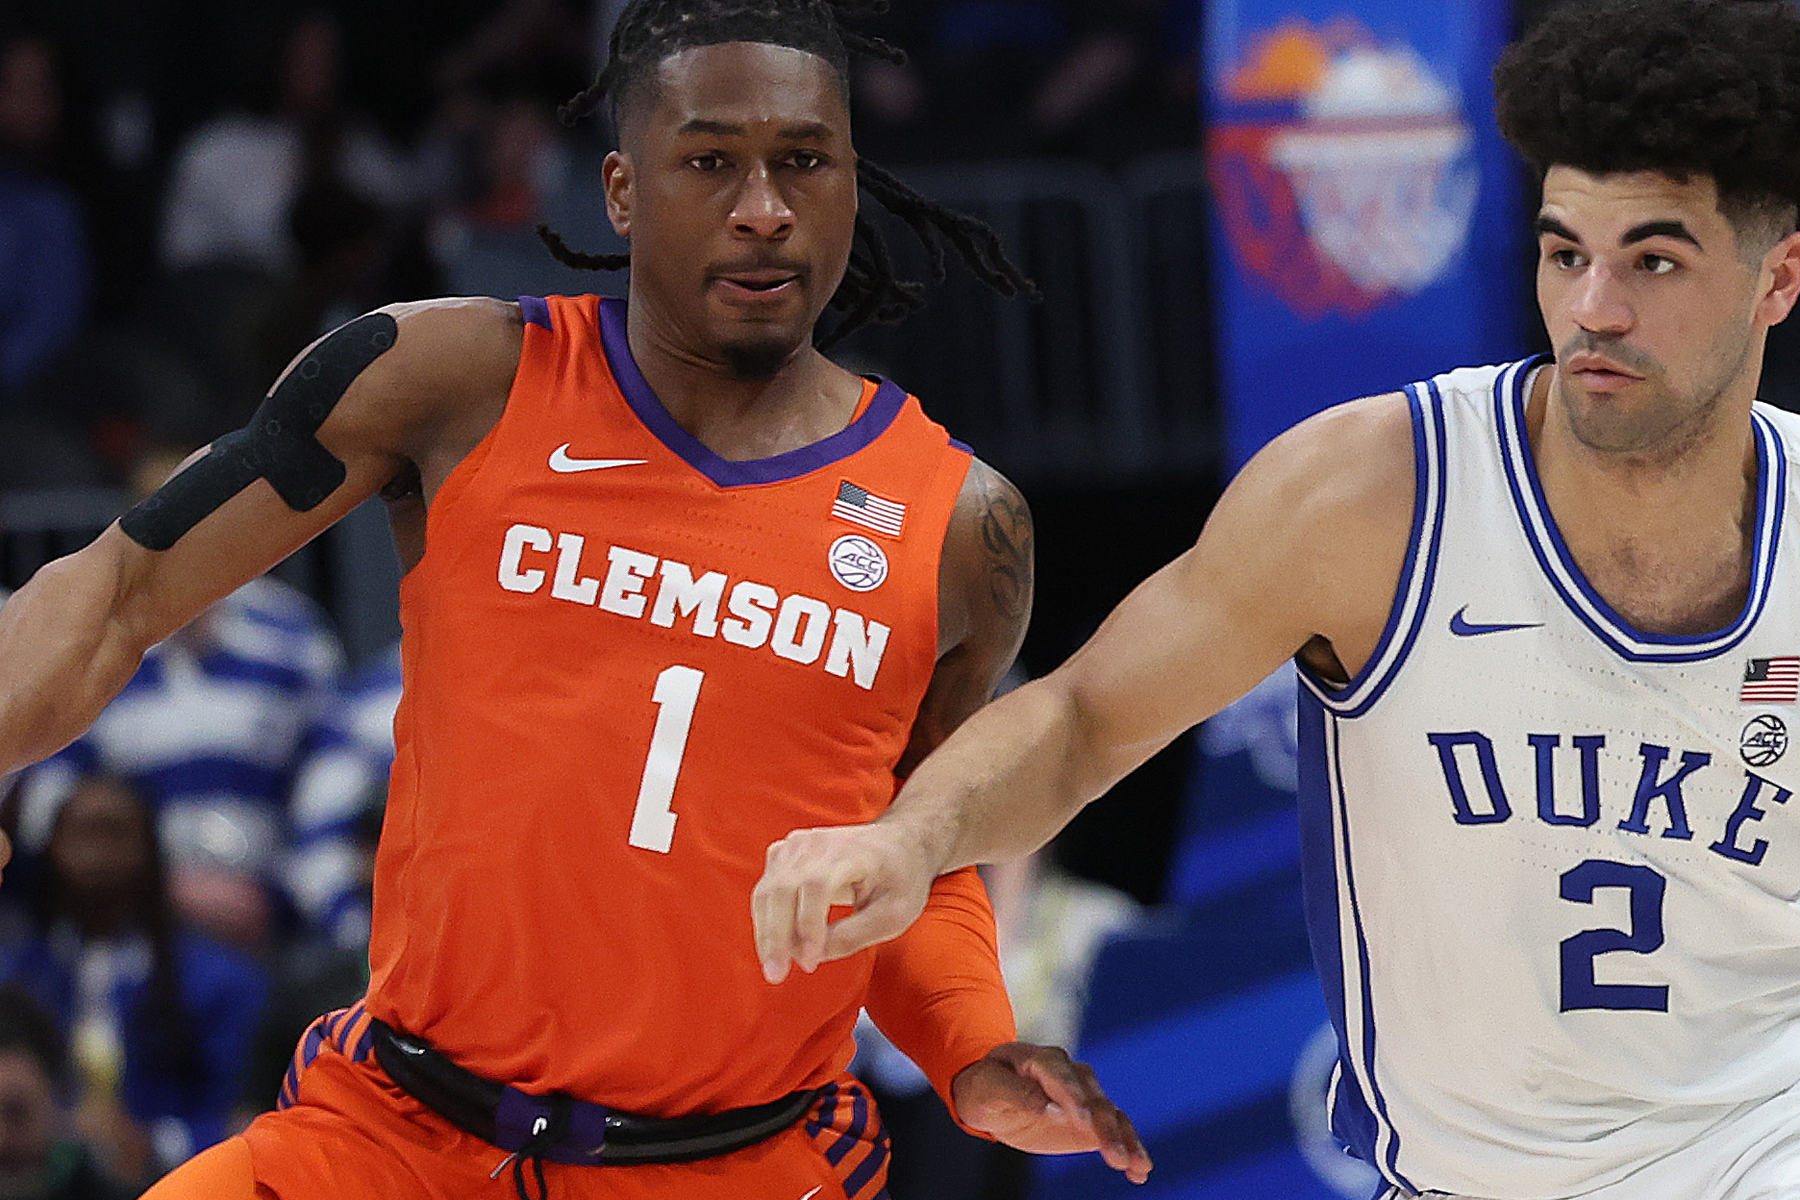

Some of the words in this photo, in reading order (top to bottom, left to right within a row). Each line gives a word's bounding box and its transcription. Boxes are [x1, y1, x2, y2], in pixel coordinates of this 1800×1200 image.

[498, 523, 890, 690] CLEMSON
[628, 664, 705, 853] 1
[1427, 731, 1793, 866] DUKE
[1559, 859, 1669, 1013] 2
